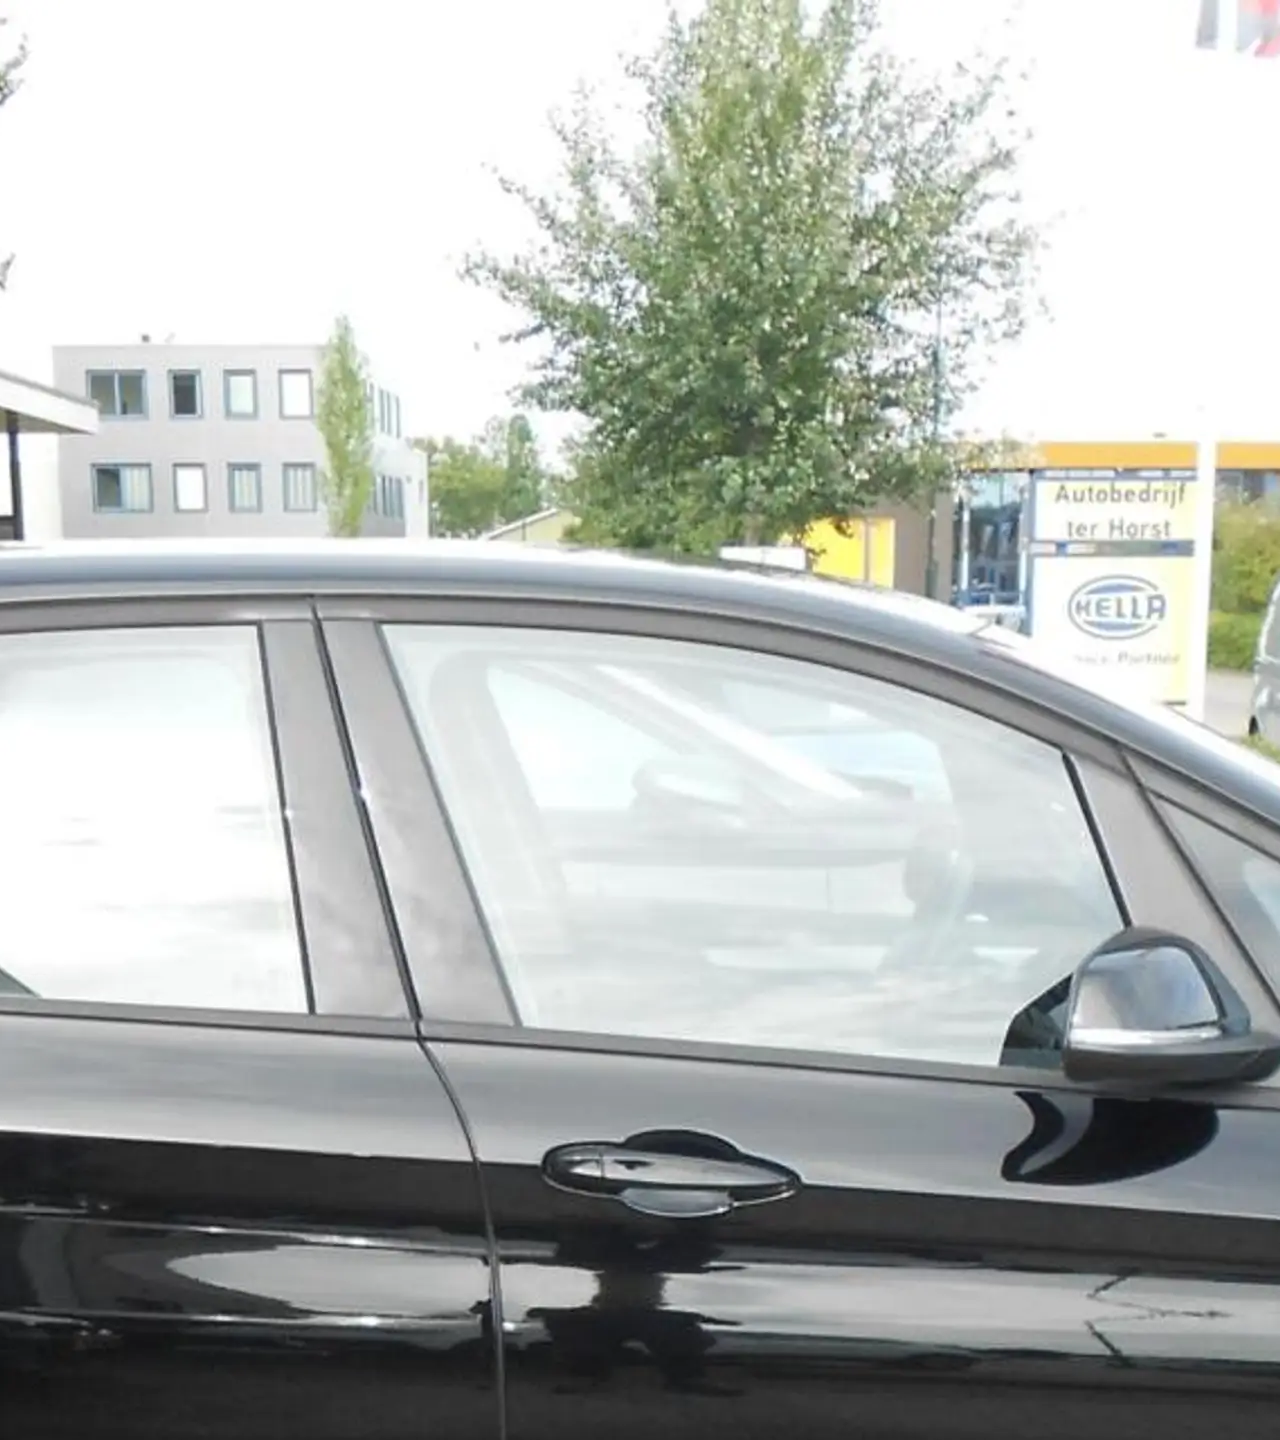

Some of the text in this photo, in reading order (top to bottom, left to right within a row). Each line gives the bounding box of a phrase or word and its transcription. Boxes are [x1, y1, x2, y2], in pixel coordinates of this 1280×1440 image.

[1054, 483, 1187, 509] Autobedrijf
[1066, 517, 1172, 539] ter Horst
[1075, 594, 1167, 621] HELLA
